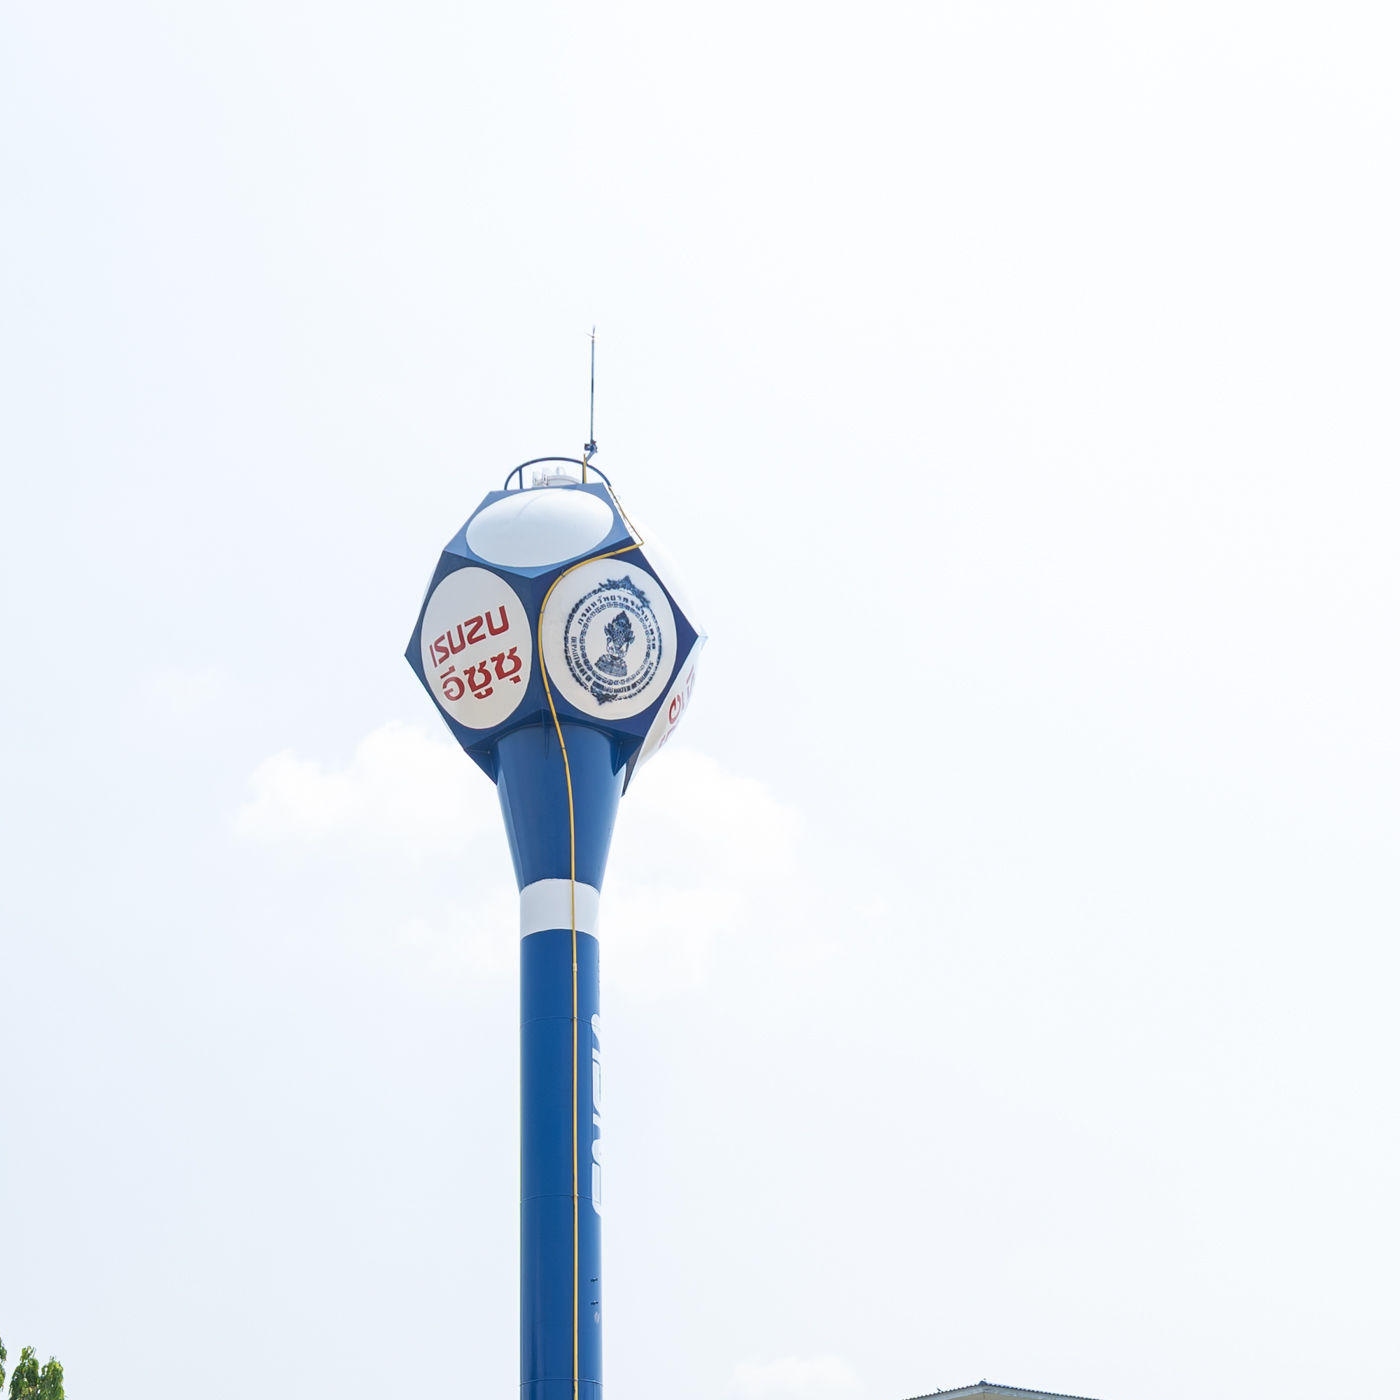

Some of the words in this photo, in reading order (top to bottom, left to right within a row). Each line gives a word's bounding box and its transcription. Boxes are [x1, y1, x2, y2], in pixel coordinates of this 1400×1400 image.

[429, 605, 510, 668] ISUZU
[440, 646, 523, 702] อีซูซุ
